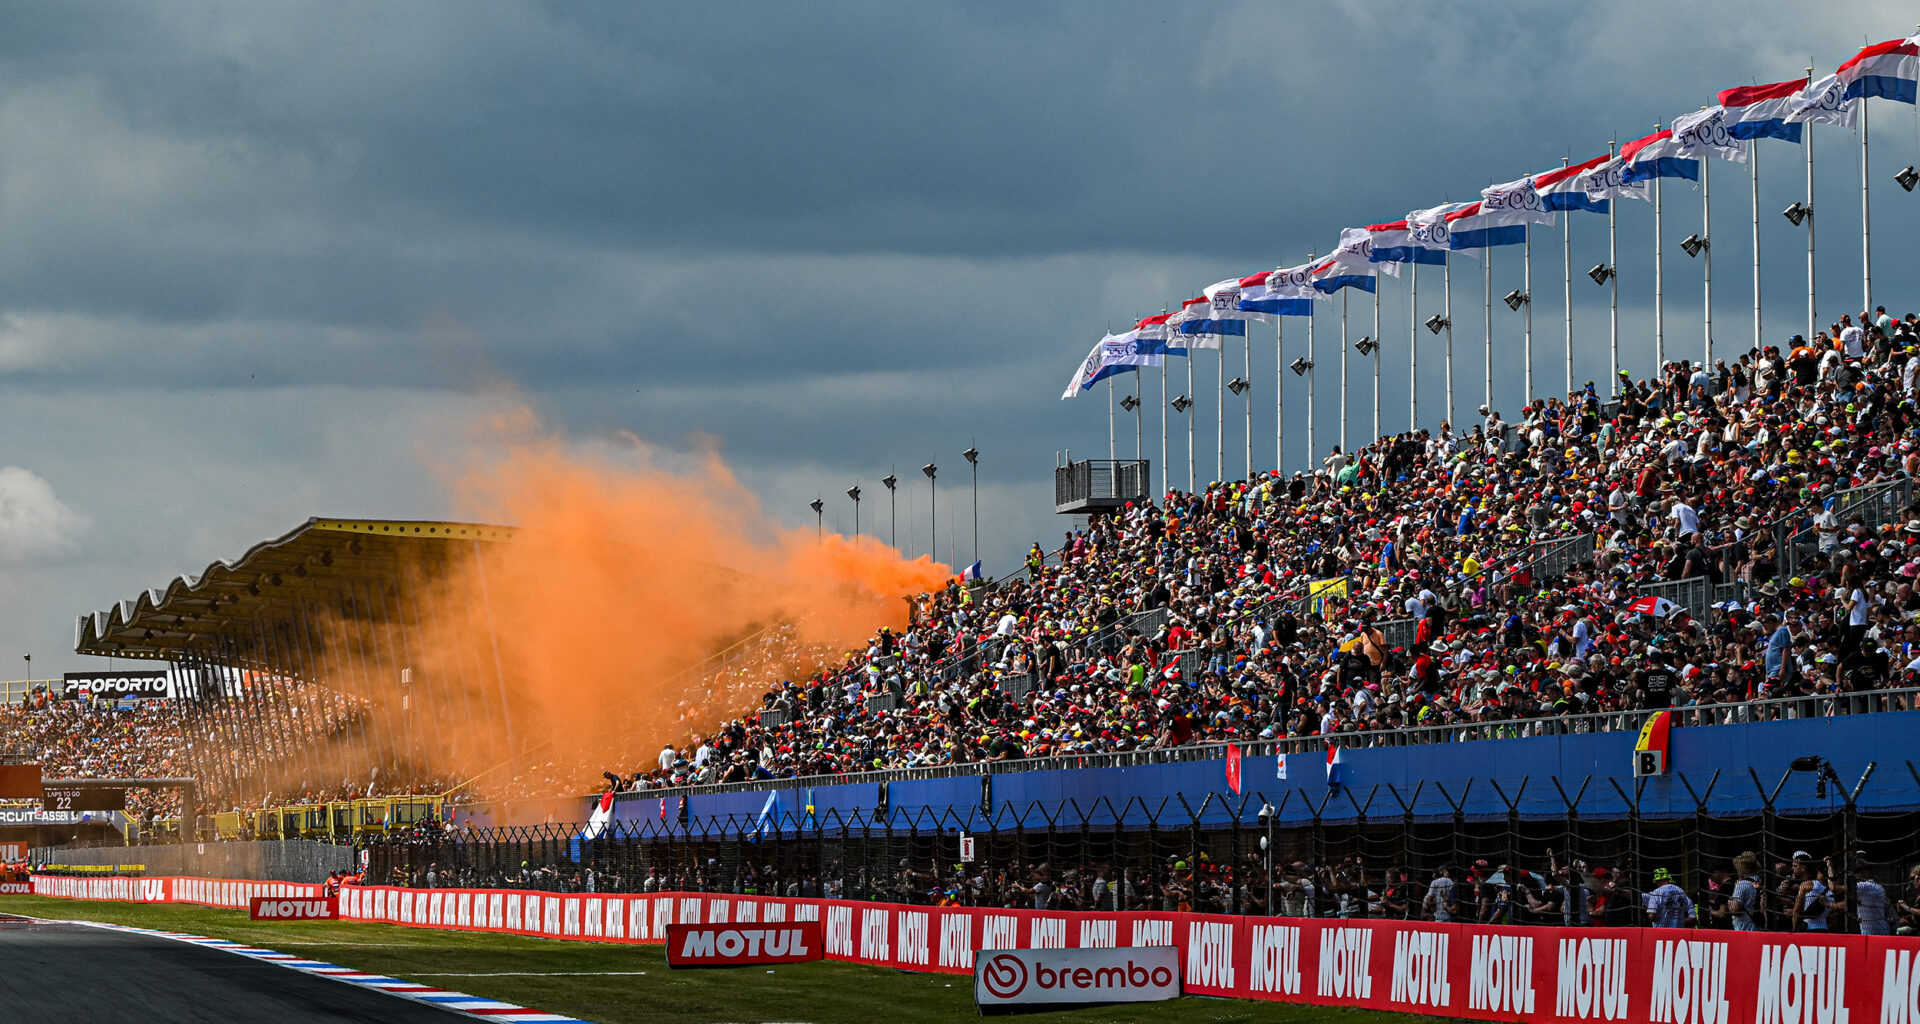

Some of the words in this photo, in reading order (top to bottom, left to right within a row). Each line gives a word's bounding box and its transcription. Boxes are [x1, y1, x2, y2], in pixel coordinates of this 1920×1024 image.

[65, 677, 167, 693] PROFORTO
[862, 739, 872, 750] 21
[1640, 752, 1657, 775] B
[56, 797, 72, 810] 22
[258, 901, 331, 917] MOTUL
[681, 929, 809, 958] MOTUL
[826, 905, 853, 957] MOTUL
[860, 908, 889, 961] MOTUL
[897, 910, 930, 966] MOTUL
[939, 912, 973, 969] MOTUL
[1187, 916, 1235, 989] MOTUL
[1249, 921, 1302, 991] MOTUL
[1317, 927, 1373, 999] MOTUL
[1391, 930, 1451, 1006] MOTUL
[1469, 934, 1536, 1011] MOTUL
[1556, 937, 1629, 1019] MOTUL
[1649, 939, 1730, 1024] MOTUL
[1755, 944, 1850, 1024] MOTUL
[1036, 960, 1173, 990] brembo
